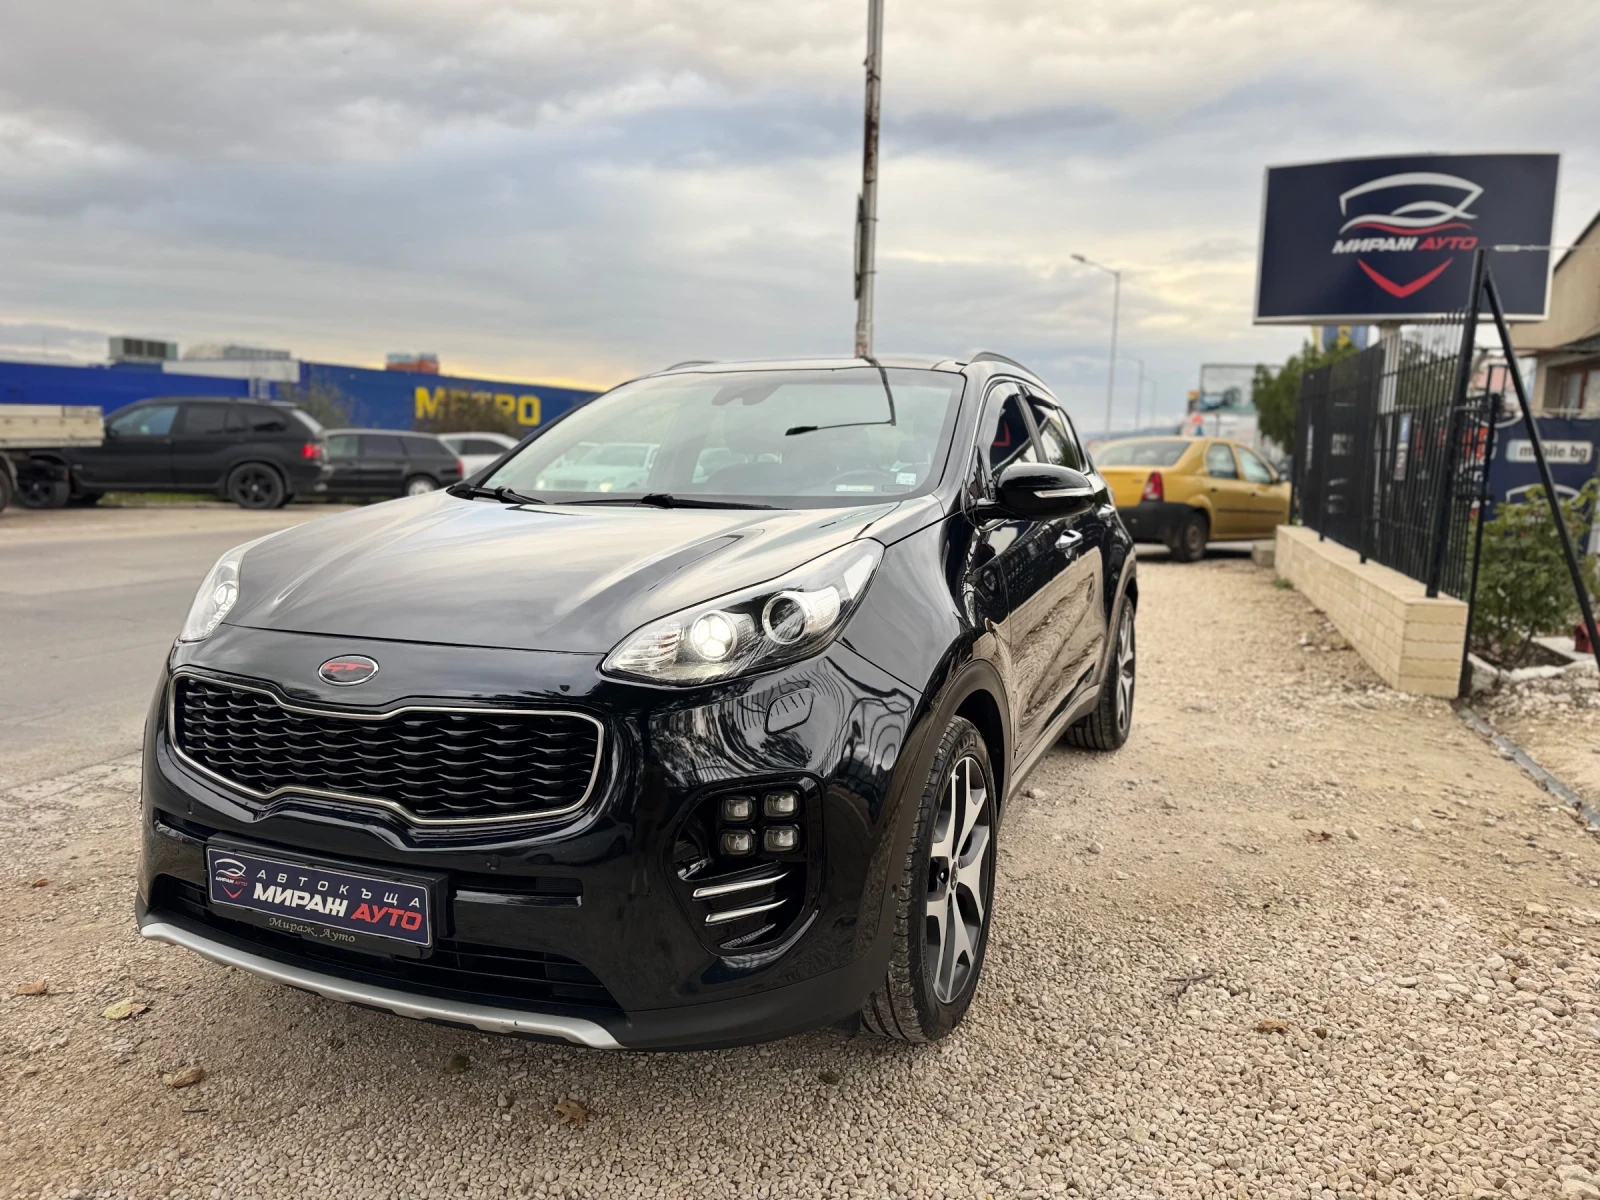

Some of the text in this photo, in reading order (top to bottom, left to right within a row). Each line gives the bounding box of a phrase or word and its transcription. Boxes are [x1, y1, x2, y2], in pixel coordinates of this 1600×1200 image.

[1332, 236, 1478, 254] МИРАЖ АУТО
[1519, 444, 1588, 461] mile.bg
[256, 869, 420, 908] АВТОКЪЩА
[253, 882, 422, 931] МИРАЖ АУТО
[269, 917, 356, 942] Мираж Ауто
